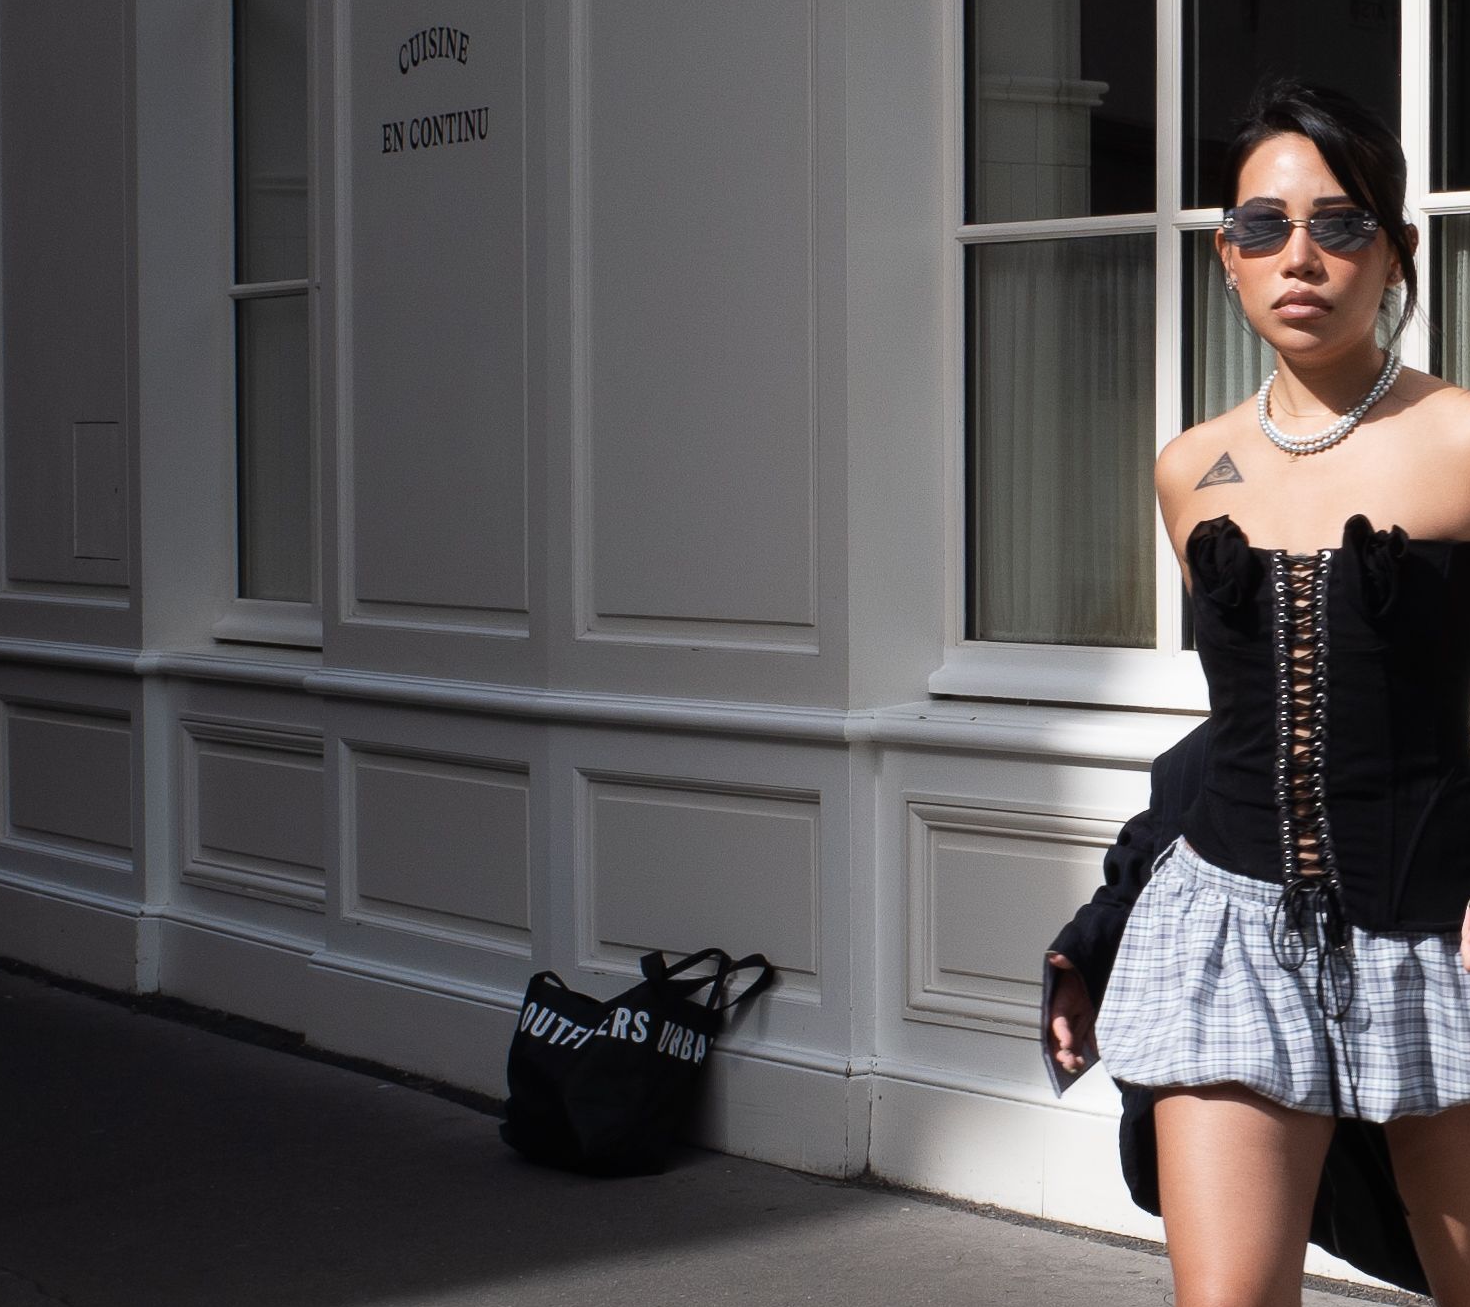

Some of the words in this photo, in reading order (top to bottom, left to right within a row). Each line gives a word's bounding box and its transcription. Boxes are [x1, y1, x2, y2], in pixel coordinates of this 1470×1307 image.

[399, 27, 469, 74] CUISINE
[382, 121, 404, 153] EN
[409, 107, 489, 149] CONTINU
[656, 1020, 714, 1065] URBA
